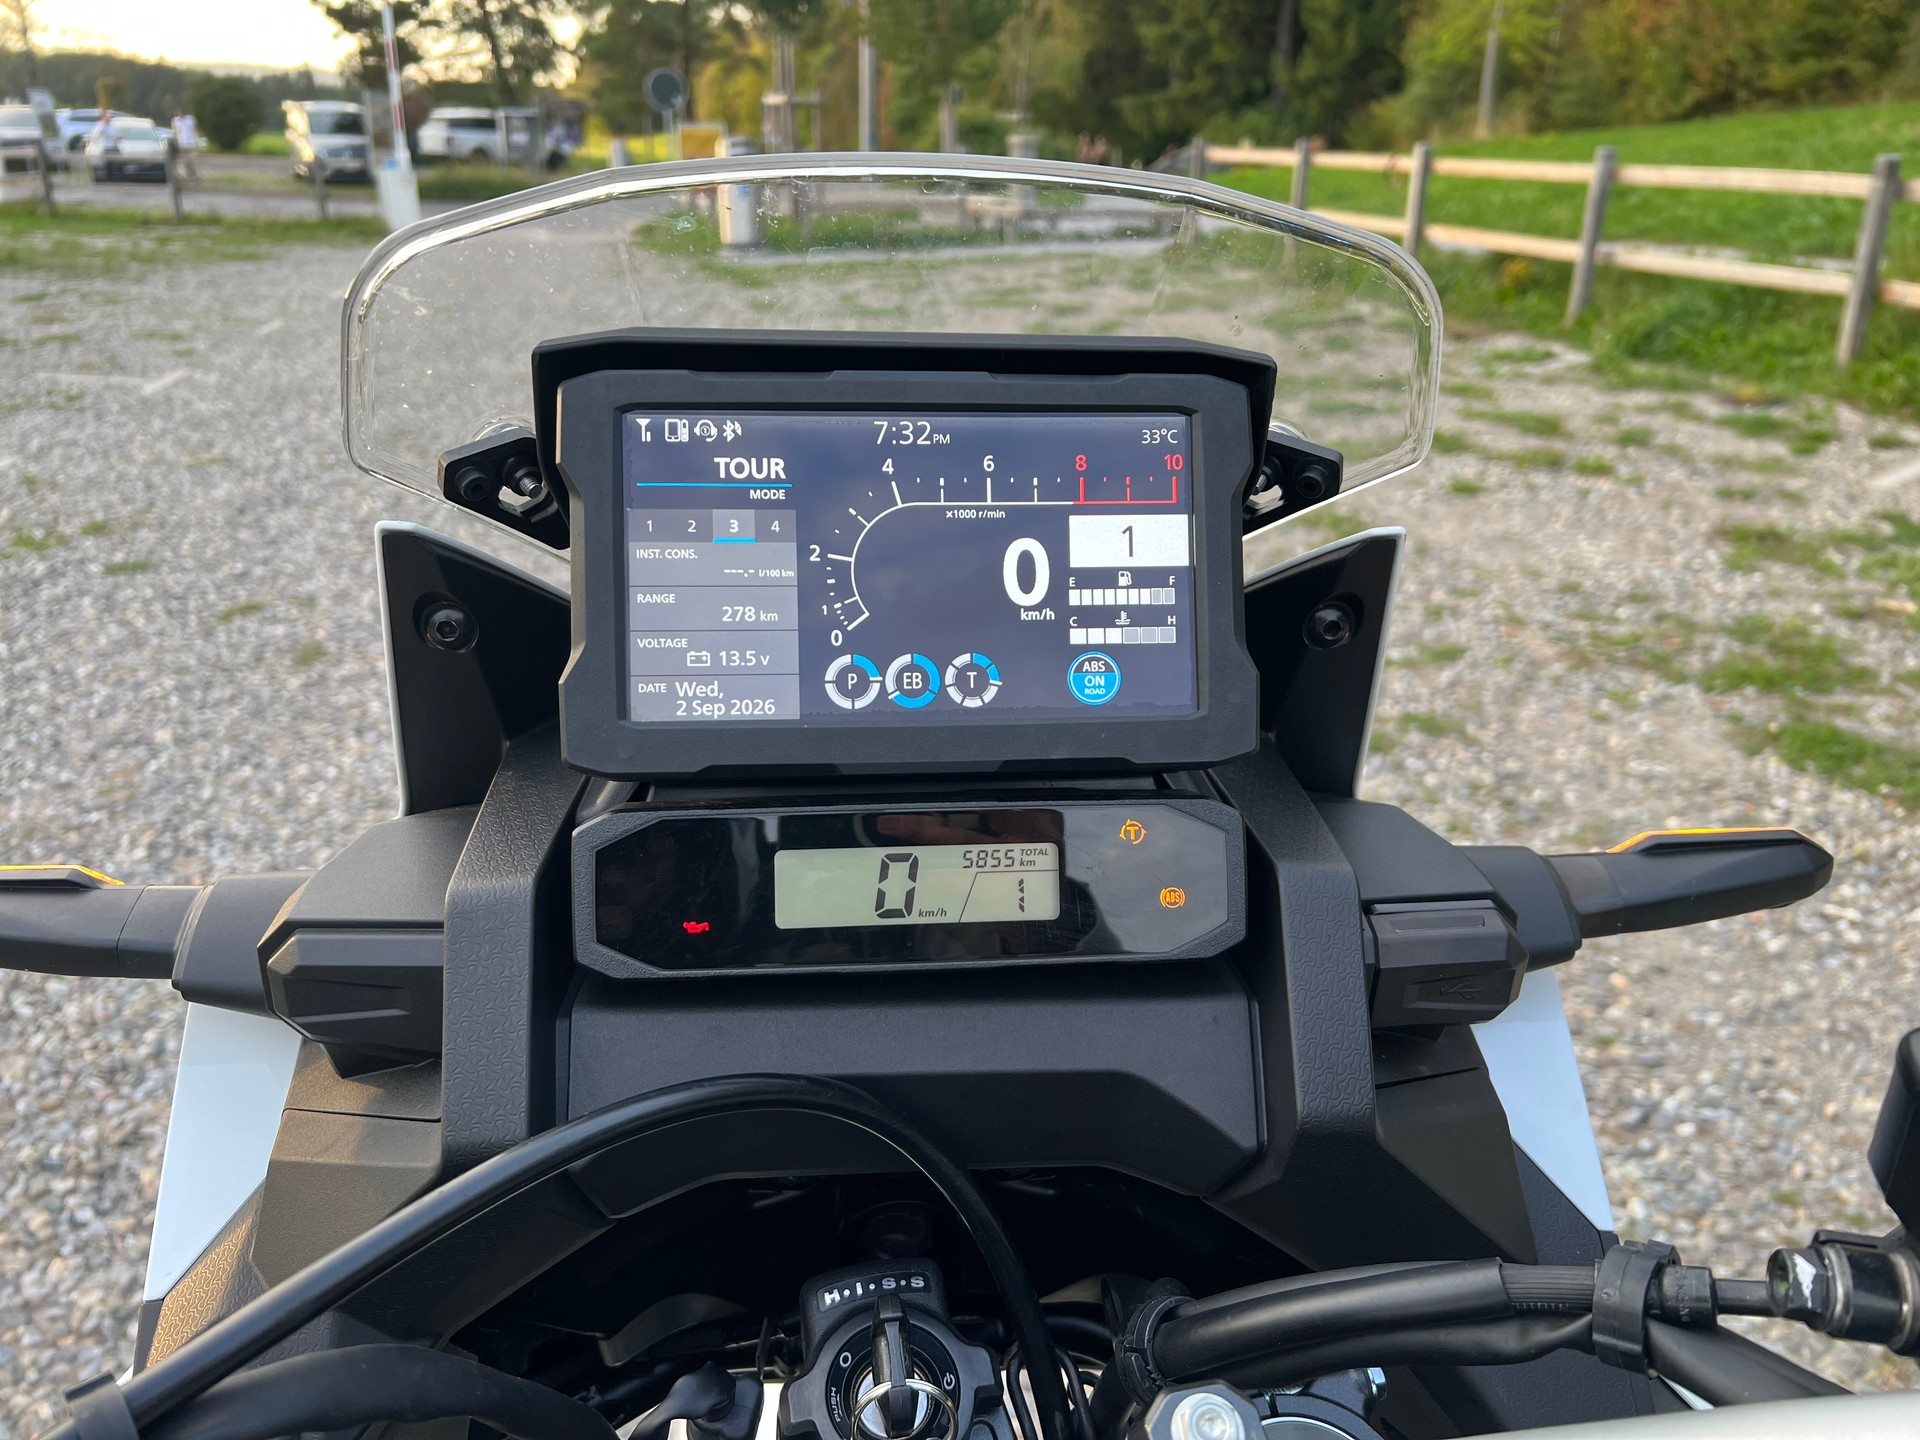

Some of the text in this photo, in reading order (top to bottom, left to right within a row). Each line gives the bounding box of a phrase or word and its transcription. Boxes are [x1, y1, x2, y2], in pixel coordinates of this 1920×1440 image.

[873, 420, 950, 445] 7:32 PM
[1141, 428, 1178, 444] 33°C
[713, 457, 786, 479] TOUR
[881, 458, 894, 475] 4
[983, 455, 995, 471] 6
[1075, 454, 1087, 471] 8
[1164, 454, 1184, 471] 10
[749, 489, 786, 500] MODE
[978, 509, 1005, 519] r/min
[646, 520, 781, 533] 1 2 3 4
[1121, 525, 1134, 558] 1
[636, 549, 698, 559] INST. CONS.
[809, 544, 821, 562] 2
[782, 568, 795, 578] km
[1002, 537, 1050, 607] 0
[1069, 575, 1176, 587] E F
[637, 593, 676, 604] RANGE
[721, 606, 779, 622] 278 km
[821, 604, 828, 615] 1
[1020, 608, 1055, 621] km/h
[1069, 615, 1176, 627] C H
[637, 638, 688, 648] VOLTAGE
[830, 629, 842, 647] 0
[719, 651, 756, 666] 13.5
[1082, 660, 1106, 672] ABS
[847, 673, 858, 690] P
[903, 672, 923, 689] EB
[966, 671, 978, 689] T
[1084, 675, 1105, 687] ON
[638, 680, 724, 699] DATE Wed,
[1084, 687, 1106, 695] ROAD
[675, 699, 775, 719] 2 Sep 2026
[962, 848, 1049, 869] 5855 TOTAL
[1019, 857, 1036, 867] km
[874, 852, 947, 919] 0 km/h
[1165, 891, 1180, 903] ABS
